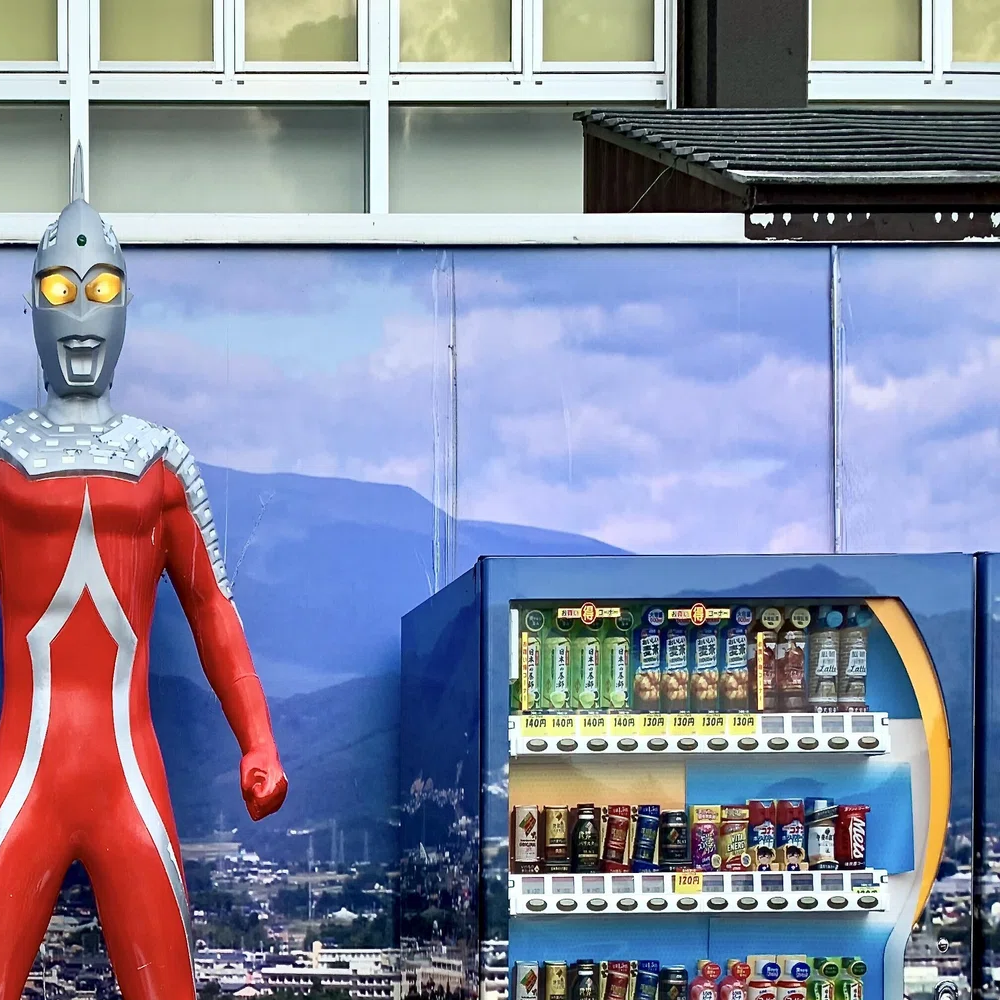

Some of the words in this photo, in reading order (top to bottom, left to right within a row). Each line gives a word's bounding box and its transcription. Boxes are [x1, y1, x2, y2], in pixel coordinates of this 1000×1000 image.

[583, 606, 594, 621] 得
[692, 607, 704, 622] 得
[525, 719, 546, 728] 140円
[552, 719, 573, 728] 140円
[584, 719, 604, 727] 140円
[614, 719, 635, 727] 140円
[644, 718, 664, 726] 130円
[674, 718, 695, 726] 130円
[702, 717, 723, 726] 130円
[733, 717, 754, 725] 130円
[853, 817, 866, 858] Mets
